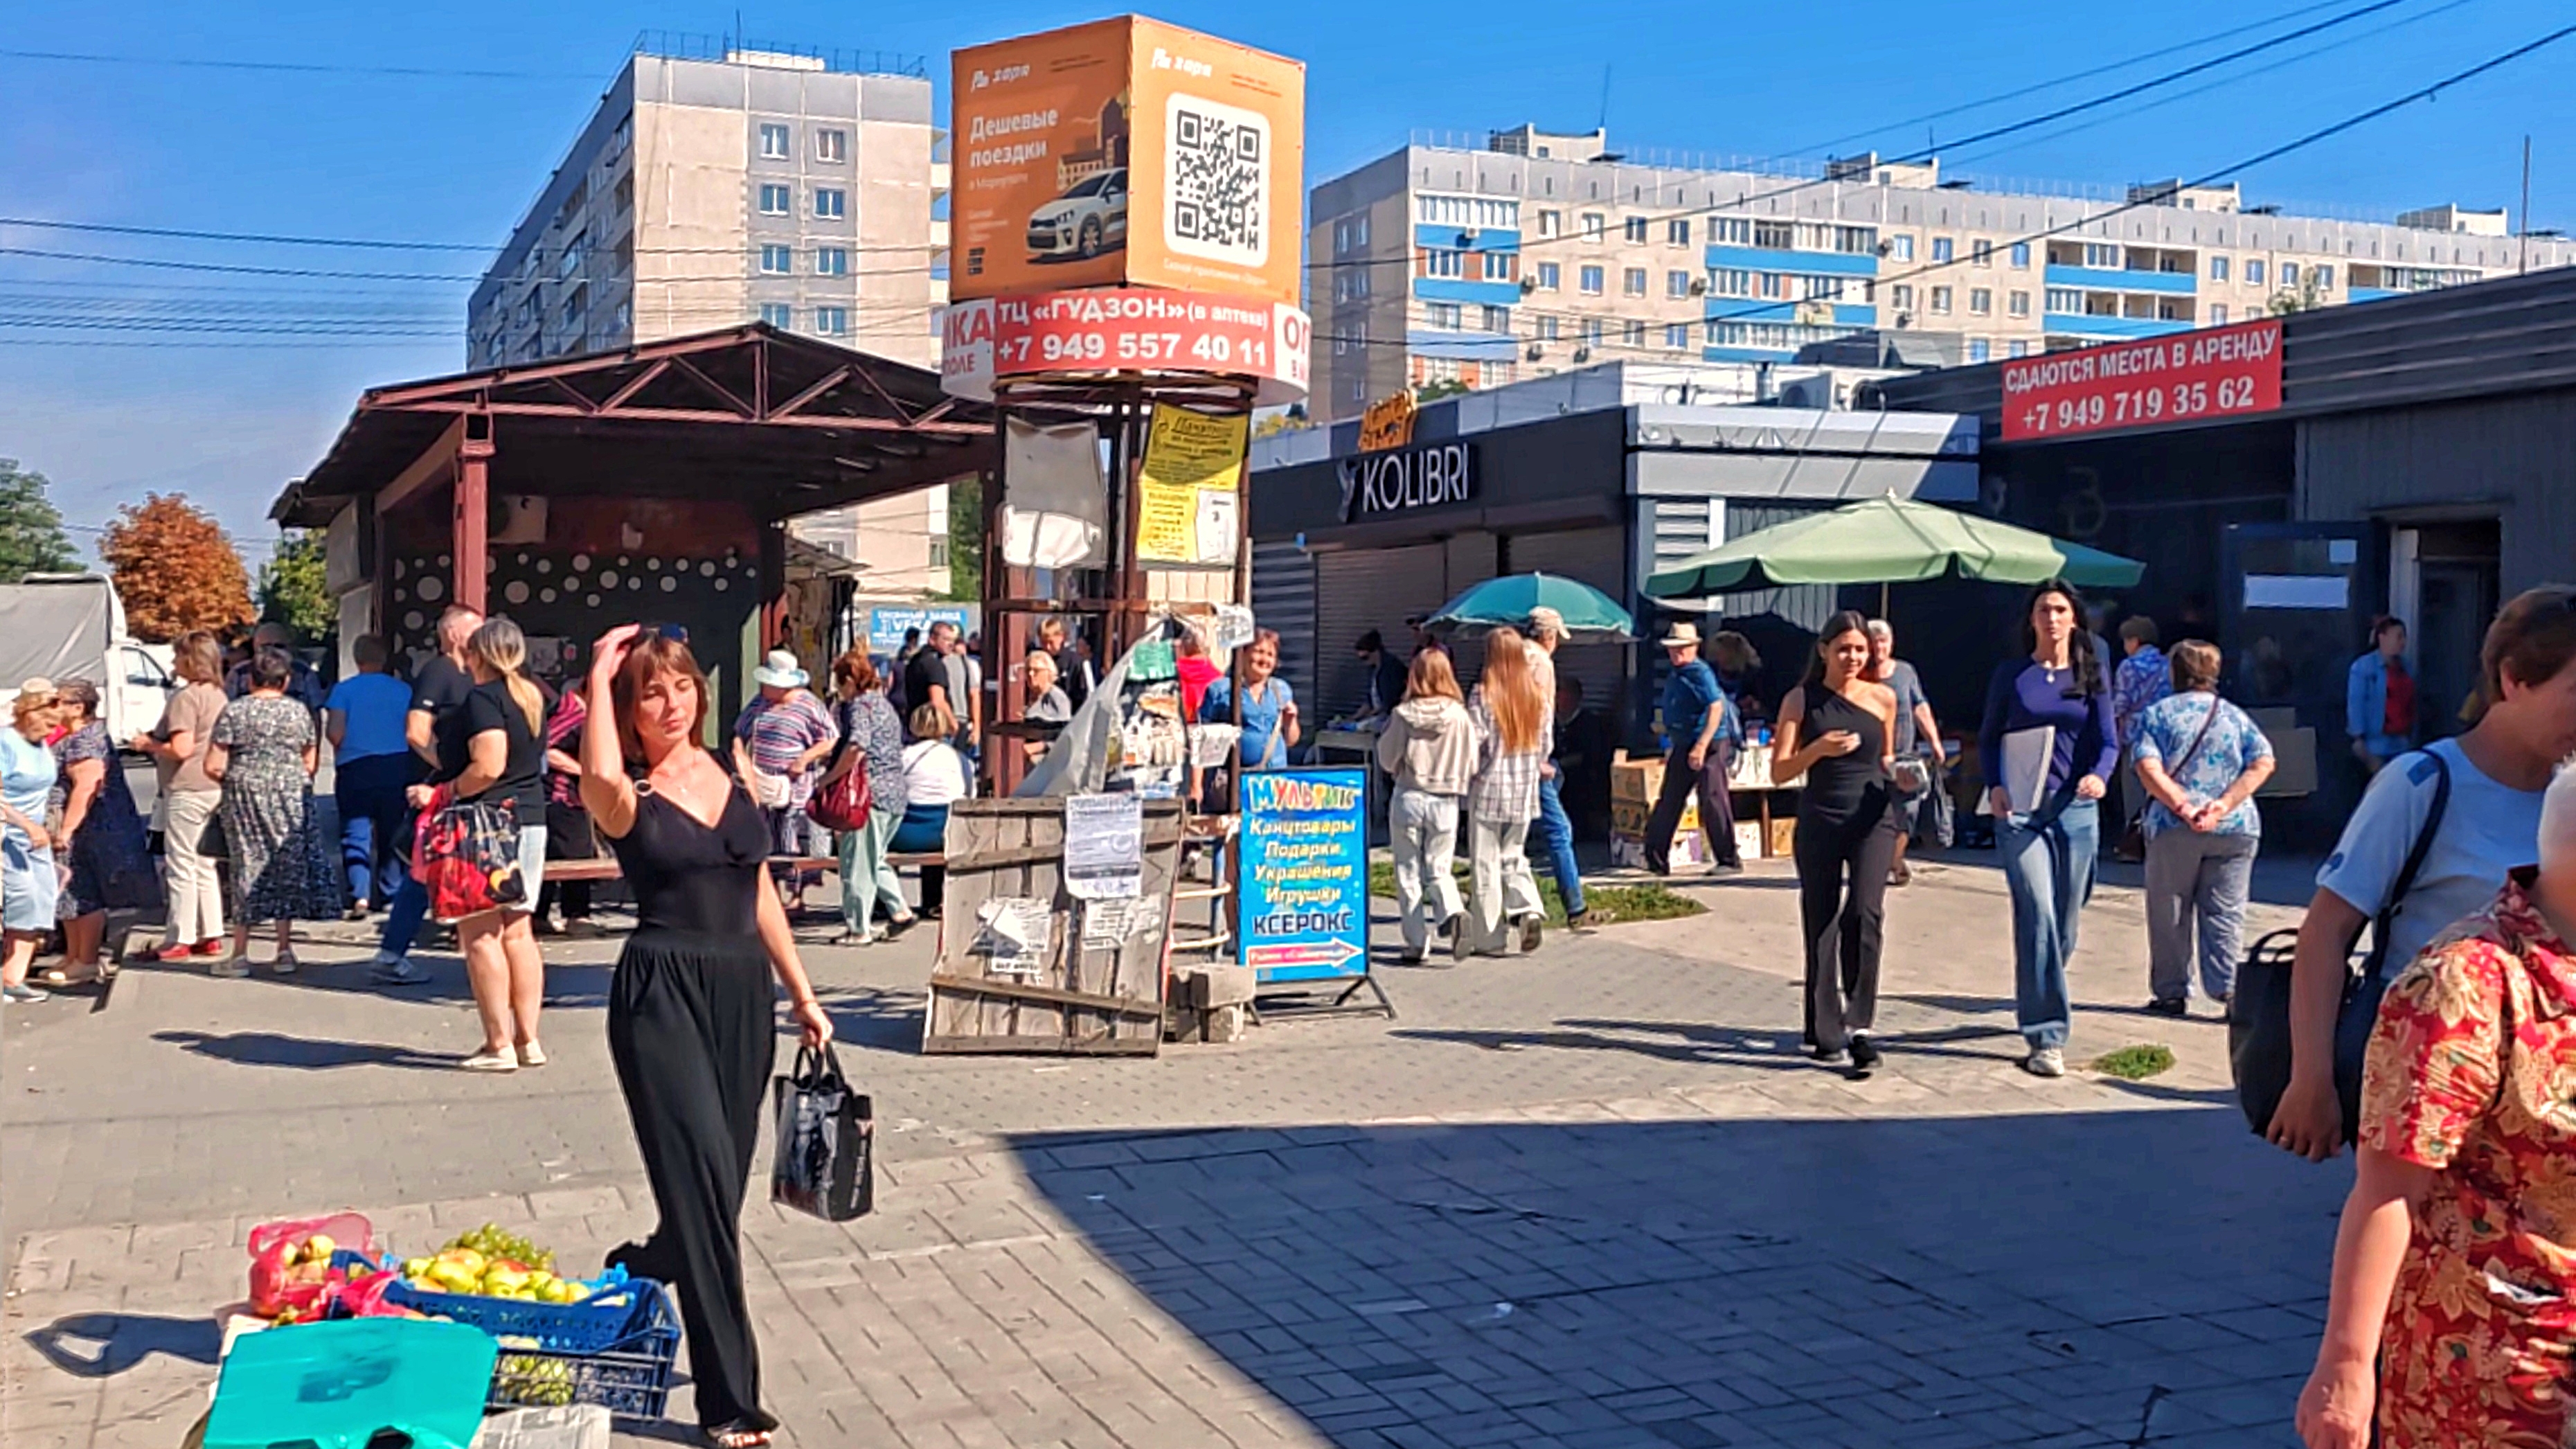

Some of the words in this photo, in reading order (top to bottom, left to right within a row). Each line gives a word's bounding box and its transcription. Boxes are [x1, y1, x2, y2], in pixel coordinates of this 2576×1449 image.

[970, 109, 1059, 145] Дешевые
[970, 141, 1047, 168] поездки
[999, 301, 1030, 326] ТЦ
[1034, 296, 1186, 324] «ГУДЗОН»
[999, 335, 1032, 362] +7
[1042, 332, 1106, 361] 949
[1118, 332, 1181, 359] 557
[1192, 334, 1230, 362] 40
[1239, 338, 1267, 366] 11
[2005, 356, 2095, 394] СДАЮТСЯ
[2100, 346, 2166, 377] МЕСТА
[2172, 343, 2186, 368] В
[2191, 328, 2278, 366] АРЕНДУ
[2023, 402, 2050, 432] +7
[2058, 395, 2106, 428] 949
[2114, 388, 2163, 421] 719
[2172, 382, 2208, 415] 35
[2218, 376, 2254, 409] 62
[1363, 443, 1468, 513] KOLIBRI
[1250, 818, 1356, 837] Канцтовары
[1265, 841, 1341, 860] Подарки
[1254, 864, 1352, 883] Украшения
[1265, 887, 1341, 907] Игрушки
[1254, 912, 1354, 934] КСЕРОКС
